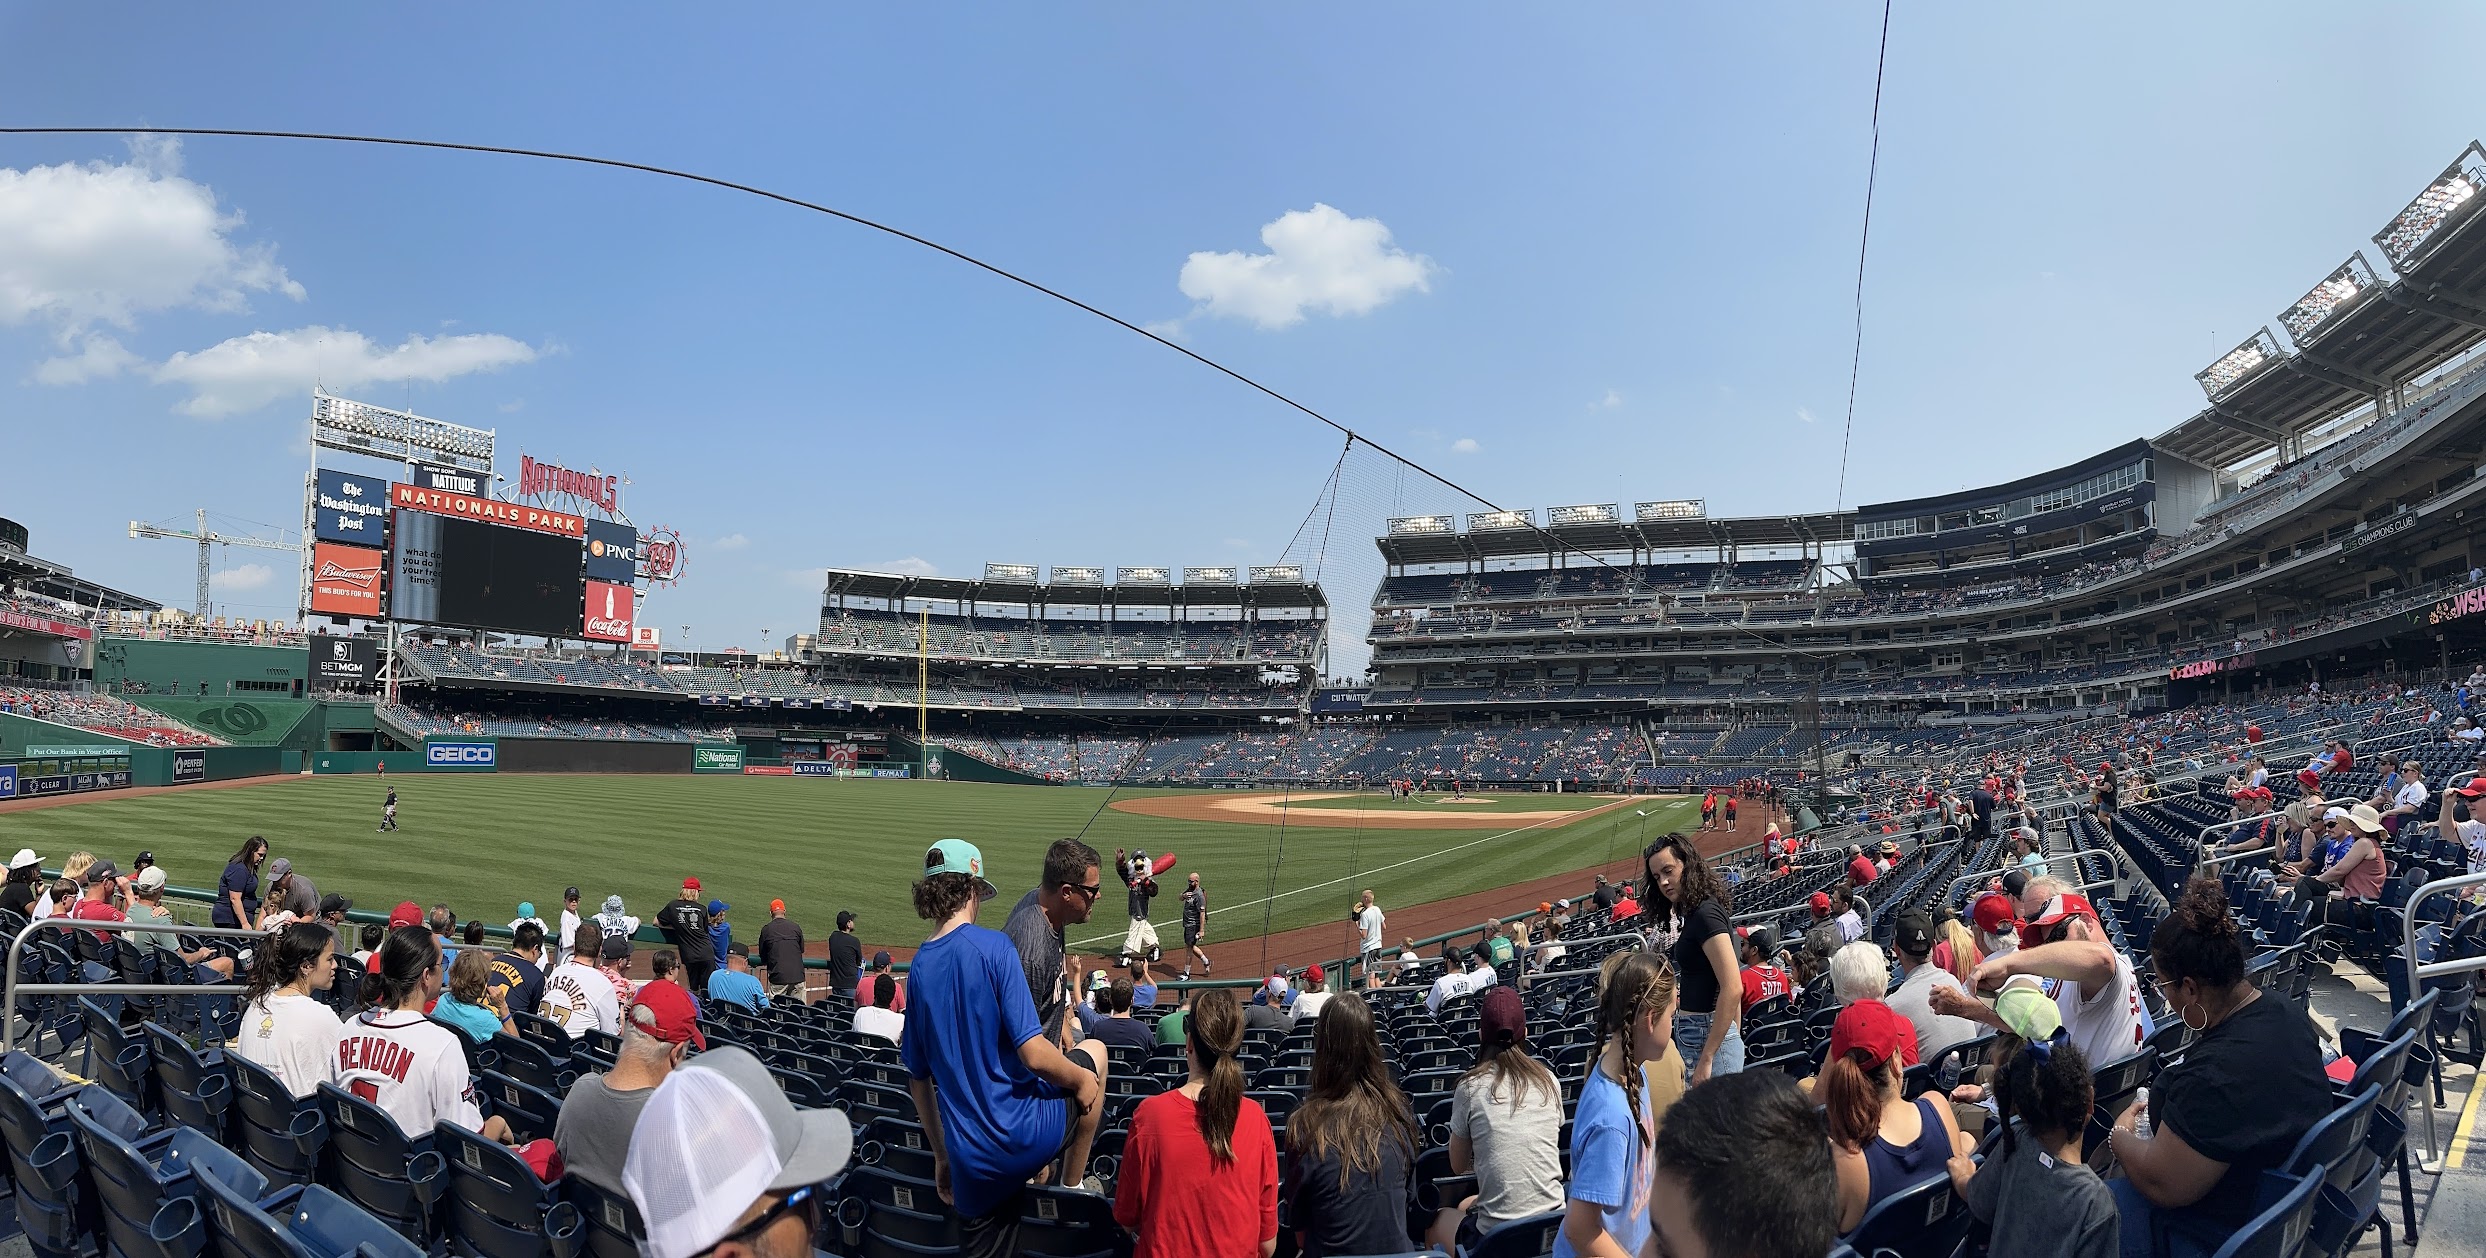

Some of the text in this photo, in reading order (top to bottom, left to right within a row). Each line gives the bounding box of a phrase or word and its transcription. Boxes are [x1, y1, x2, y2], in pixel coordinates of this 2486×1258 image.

[342, 482, 362, 498] The
[432, 474, 476, 492] NATITUDE
[520, 455, 617, 513] NATIONALS
[320, 494, 383, 518] Washington
[400, 488, 576, 532] NATIONALS PARK
[338, 515, 364, 531] Post
[2358, 524, 2394, 546] CHAMPIONS
[2395, 516, 2413, 531] CLUB
[406, 548, 442, 559] what do
[605, 544, 634, 561] PNC
[403, 556, 420, 566] you
[422, 558, 433, 567] do
[321, 564, 374, 582] Budweiser
[402, 566, 424, 577] your
[410, 576, 435, 586] time?
[333, 588, 350, 596] BUD'S
[362, 590, 376, 599] YOU.
[8, 612, 25, 626] BUD'S
[26, 616, 38, 629] FOR
[588, 617, 630, 638] Coca-Cola
[321, 662, 362, 672] BETMGM
[430, 747, 492, 762] GEICO
[708, 752, 738, 762] National
[184, 759, 203, 768] PENFED
[41, 781, 60, 789] CLEAR
[77, 775, 92, 784] MGM
[1761, 981, 1782, 996] SOTO
[340, 1036, 415, 1084] RENDON
